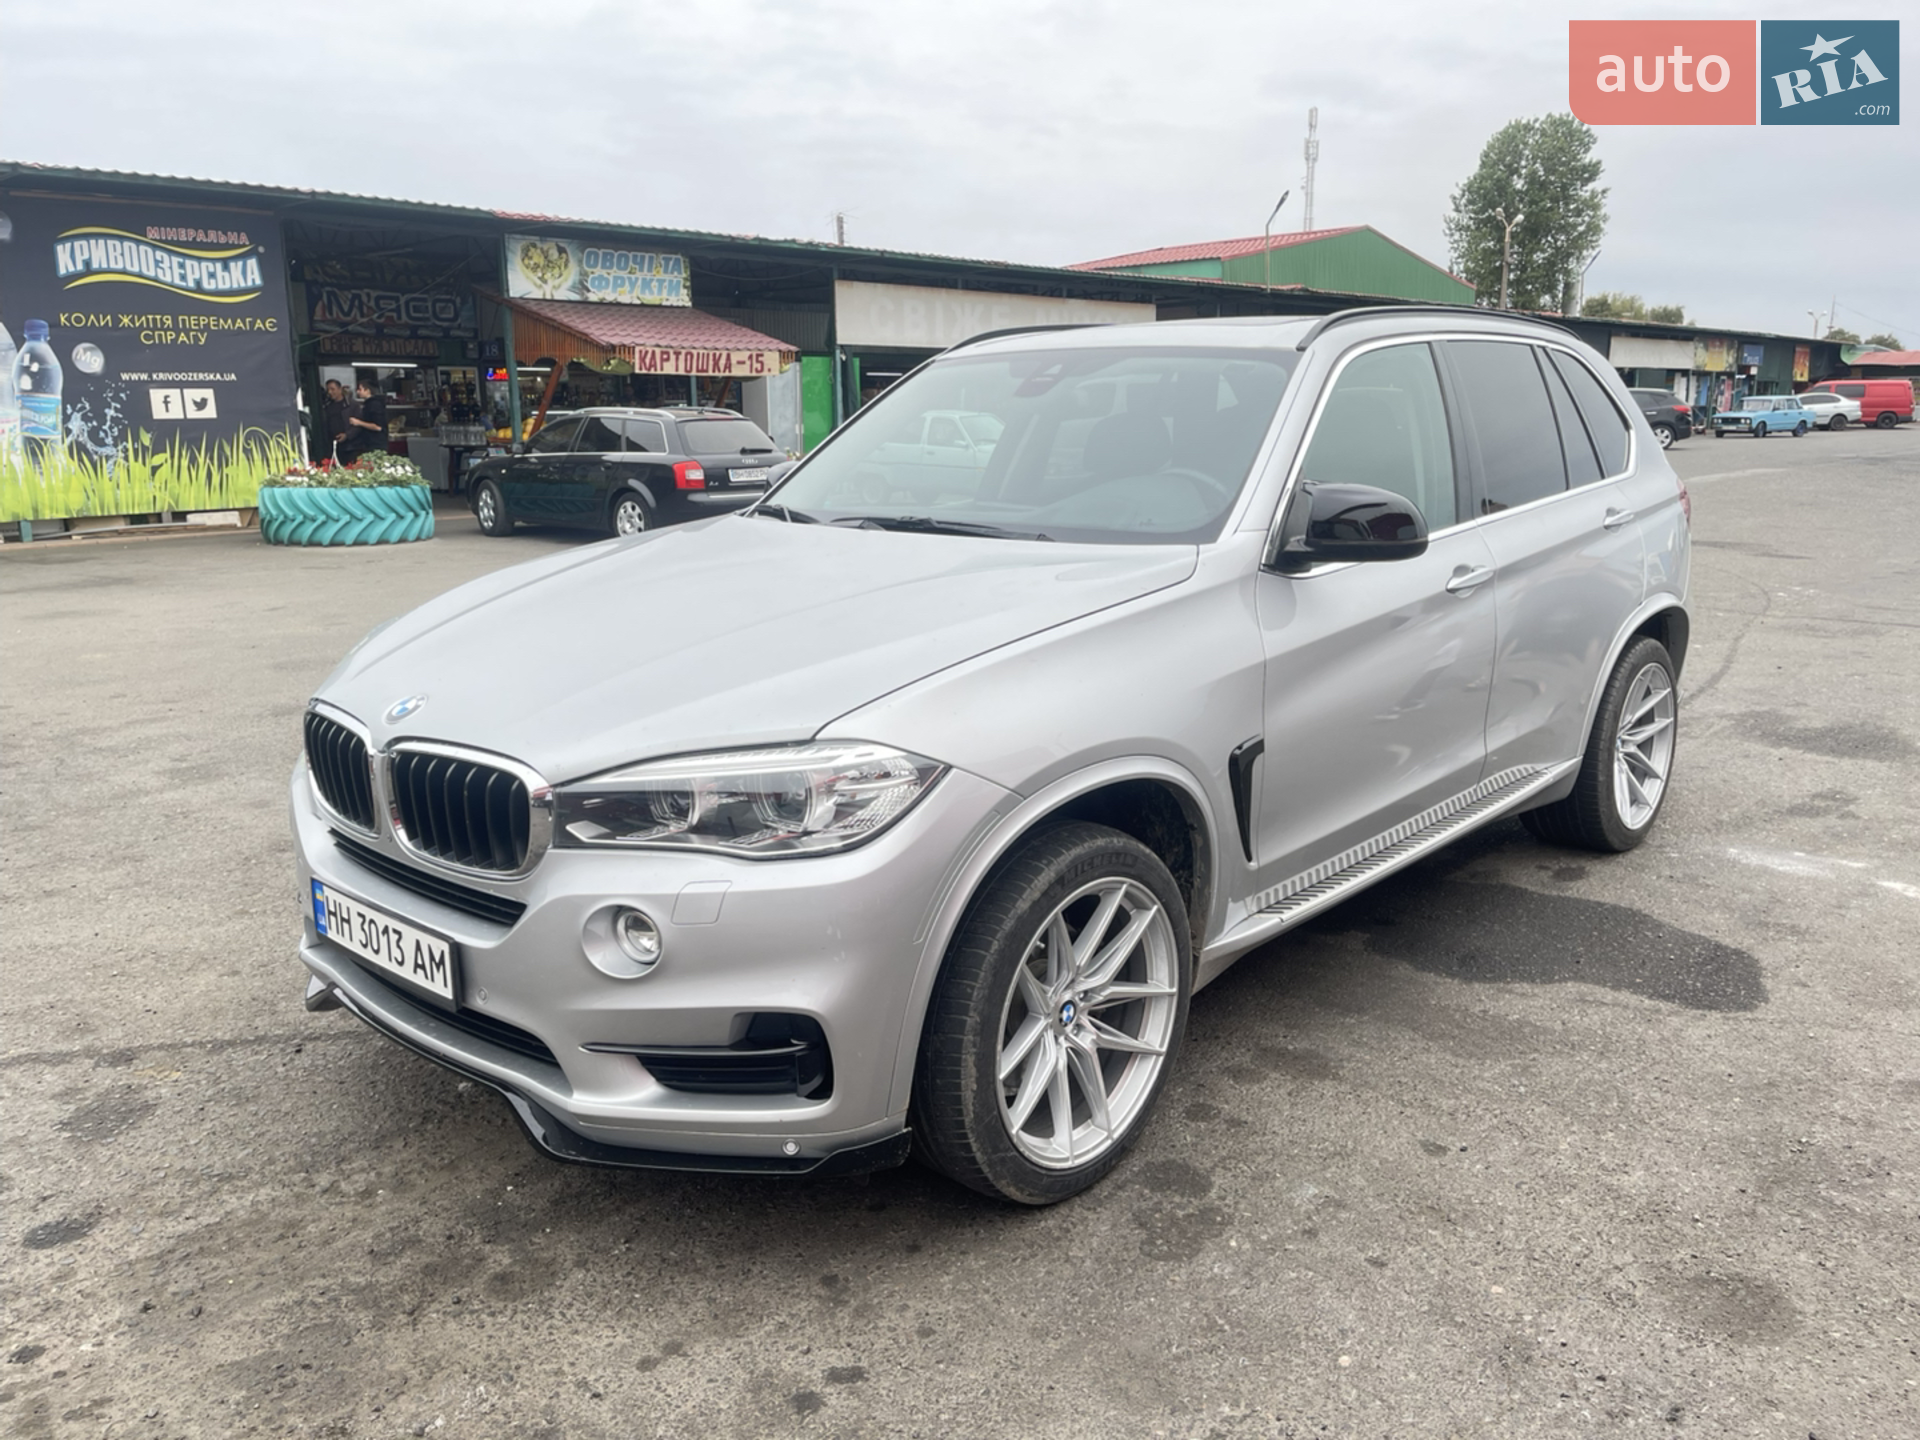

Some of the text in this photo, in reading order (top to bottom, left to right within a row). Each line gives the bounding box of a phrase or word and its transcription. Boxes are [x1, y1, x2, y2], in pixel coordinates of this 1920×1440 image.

[146, 226, 250, 245] МІНЕРАЛЬНА
[55, 238, 262, 291] КРИВООЗЕРСЬКА
[584, 248, 683, 275] ОВОЧІ ТА
[589, 273, 682, 297] ФРУКТИ
[59, 313, 278, 332] КОЛИ ЖИТТЯ ПЕРЕМАГАЄ
[140, 331, 208, 345] СПРАГУ
[76, 347, 101, 369] Mg
[485, 344, 499, 357] 18
[325, 895, 448, 989] HH 3013 AM
